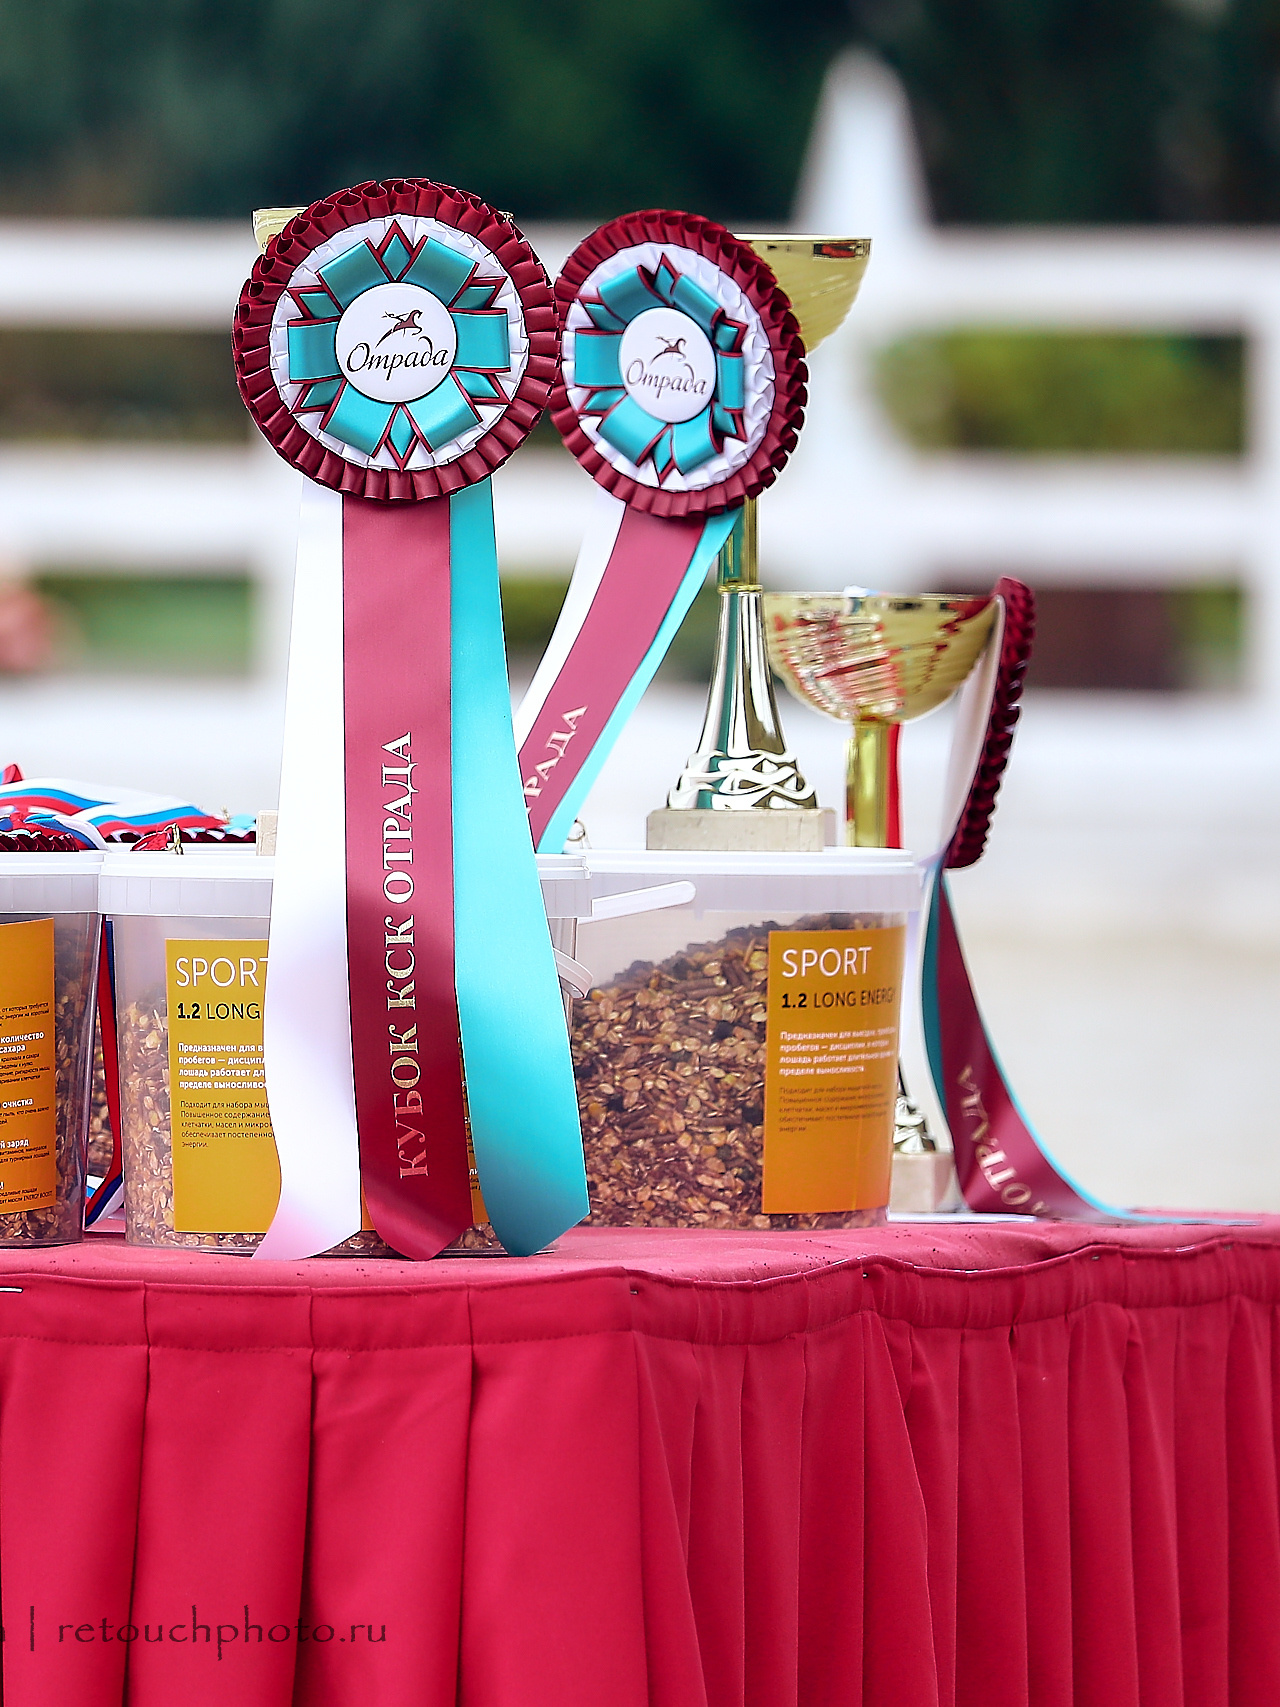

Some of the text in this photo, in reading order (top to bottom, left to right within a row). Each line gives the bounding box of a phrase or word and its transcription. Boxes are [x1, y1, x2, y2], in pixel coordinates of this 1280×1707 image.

[346, 336, 450, 381] Отрада
[625, 359, 708, 397] Отрада
[523, 705, 588, 814] РАДА
[382, 732, 429, 1179] КУБОК КСК ОТРАДА
[782, 946, 872, 978] SPORT
[782, 993, 807, 1008] 1.2
[815, 991, 856, 1008] LONG
[177, 1003, 261, 1019] 1.2 LONG
[0, 1032, 44, 1043] количество
[179, 1043, 236, 1053] Предназначен
[179, 1056, 215, 1065] пробегов
[210, 1068, 250, 1078] работает
[179, 1081, 212, 1089] пределе
[3, 1098, 33, 1108] очистка
[7, 1139, 29, 1147] заряд
